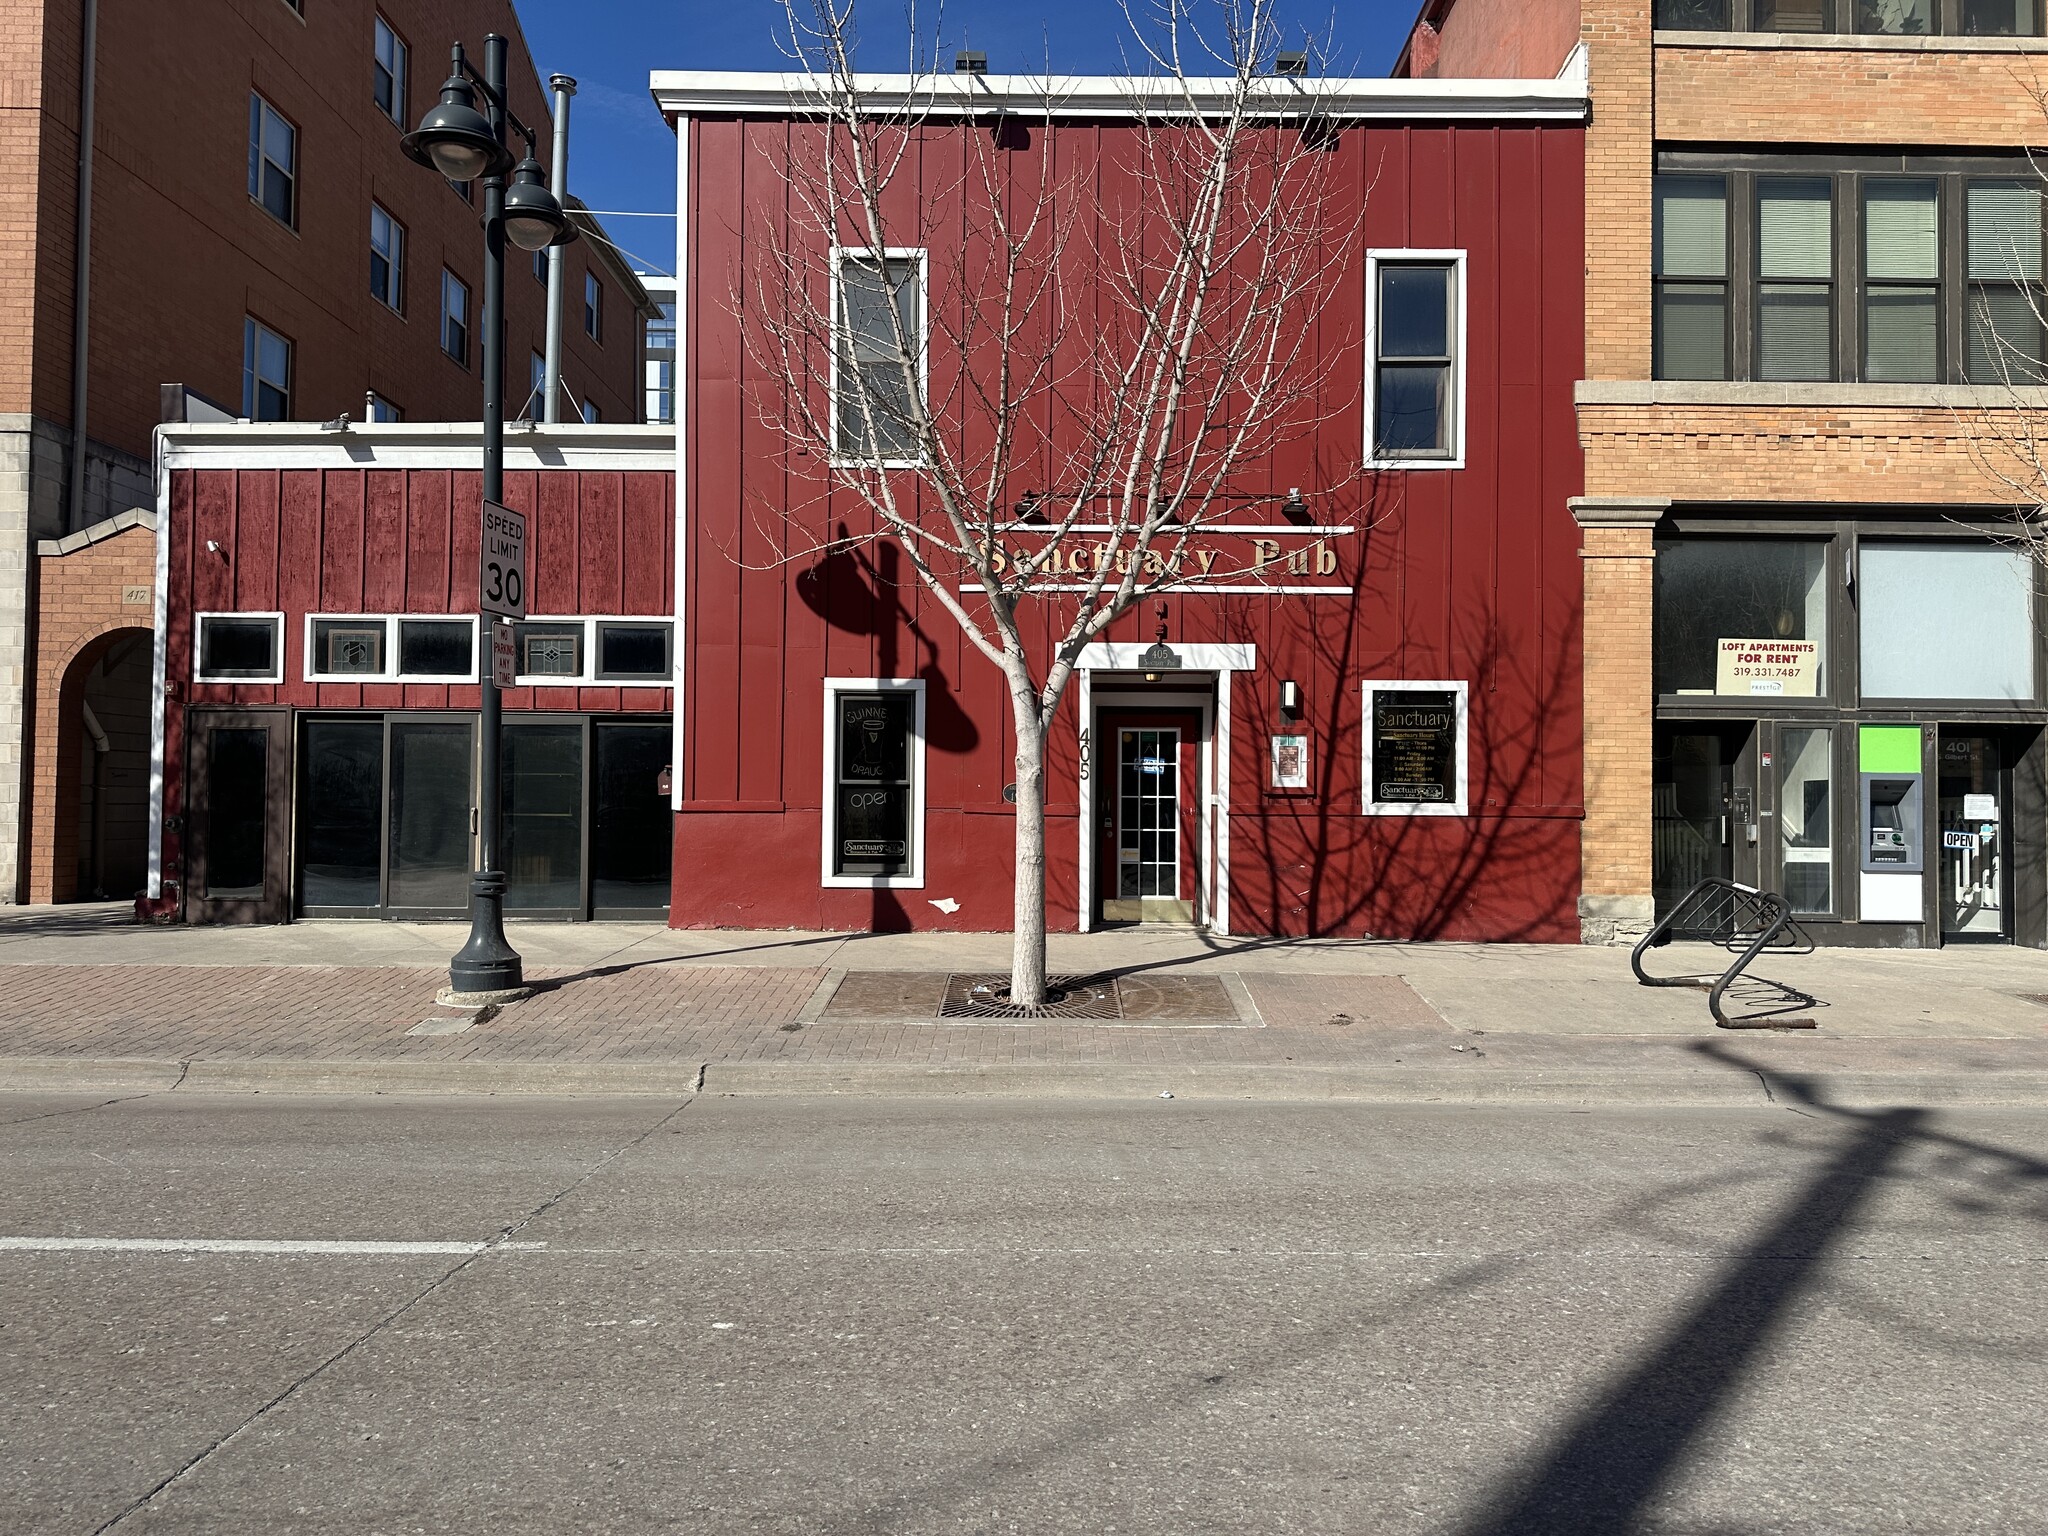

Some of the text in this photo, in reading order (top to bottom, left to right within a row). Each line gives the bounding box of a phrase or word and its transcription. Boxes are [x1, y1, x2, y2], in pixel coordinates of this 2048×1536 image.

[487, 513, 523, 540] SPEED
[490, 536, 519, 561] LIMIT
[1252, 538, 1337, 576] Pub
[486, 562, 522, 607] 30
[126, 590, 147, 601] 417
[501, 629, 508, 641] NO
[495, 642, 514, 657] PARKING
[1151, 649, 1169, 659] 405
[1722, 643, 1814, 652] LOFT APARTMENTS
[499, 658, 511, 670] ANY
[1737, 653, 1799, 664] FOR RENT
[498, 671, 512, 685] TIME
[1733, 667, 1801, 678] 319.331.7487
[847, 707, 888, 724] GUINNE
[1378, 710, 1451, 730] Sanctuary
[1079, 727, 1091, 781] 405
[1946, 742, 1970, 753] 401
[851, 763, 884, 776] DRAUG
[1383, 784, 1421, 797] Sanctuary
[850, 792, 894, 810] open
[1946, 833, 1974, 847] OPEN
[846, 842, 884, 853] Sanctuary
